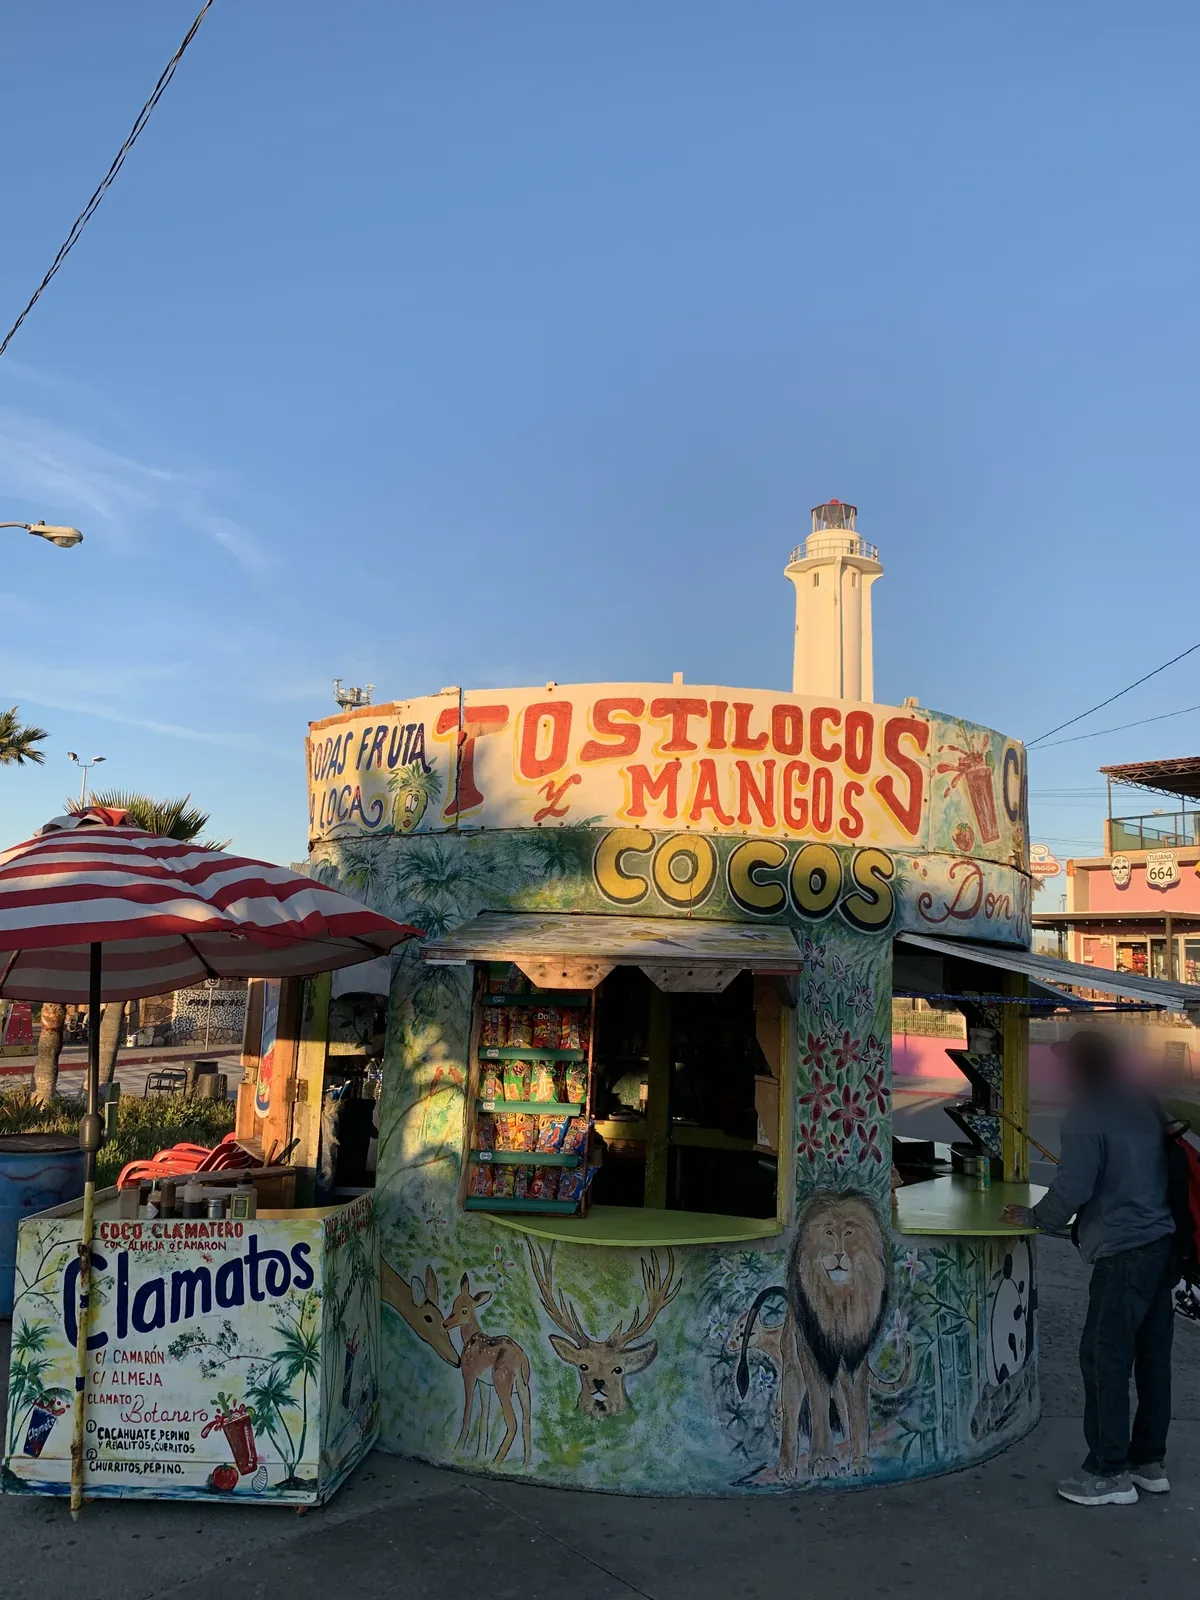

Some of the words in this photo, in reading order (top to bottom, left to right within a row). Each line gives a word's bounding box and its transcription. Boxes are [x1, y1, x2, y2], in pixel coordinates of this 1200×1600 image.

[355, 722, 432, 775] FRUTA
[434, 697, 930, 836] TOSTILOCOS
[319, 783, 384, 829] LOCA
[624, 758, 865, 838] MANGOS
[592, 826, 896, 934] COCOS
[1149, 866, 1173, 880] 664
[99, 1221, 143, 1240] COCO
[151, 1220, 244, 1239] CLAMATERO
[62, 1233, 315, 1351] Clamatos
[87, 1393, 132, 1405] CLAMATO
[111, 1370, 163, 1387] ALMEJA
[120, 1394, 209, 1424] Botanero
